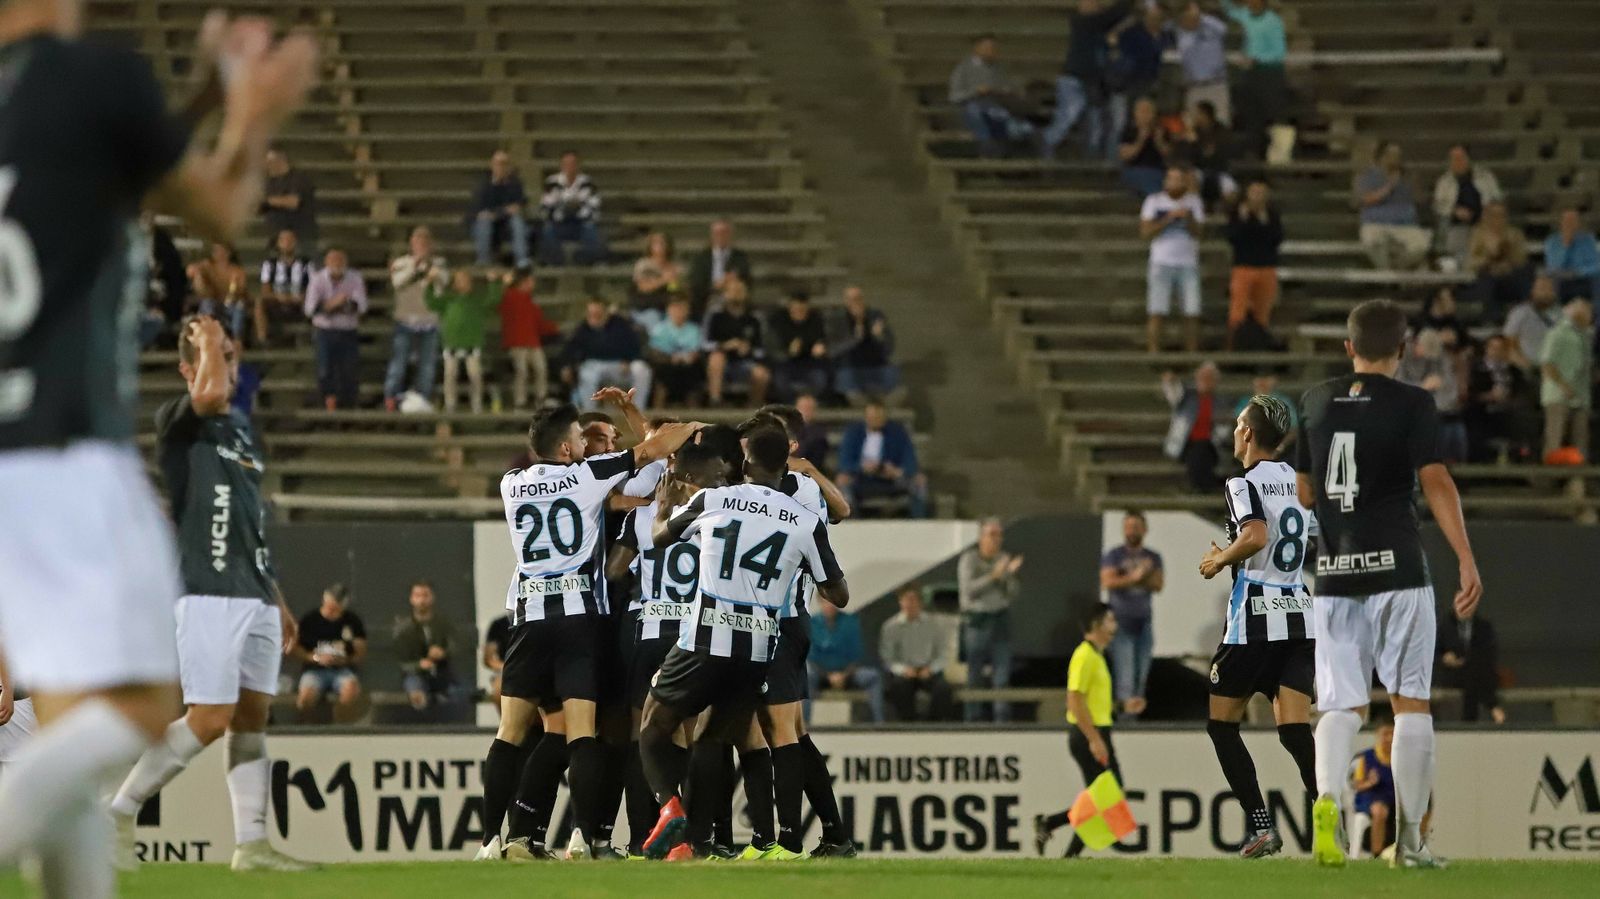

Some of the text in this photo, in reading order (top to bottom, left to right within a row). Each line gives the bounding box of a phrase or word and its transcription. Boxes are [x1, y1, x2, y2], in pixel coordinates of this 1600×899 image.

[510, 474, 579, 498] J.FORJAN
[1325, 432, 1360, 512] 4
[515, 497, 583, 563] 20
[722, 497, 800, 526] MUSA. BK
[712, 518, 788, 591] 14
[1273, 507, 1304, 572] 8
[643, 542, 700, 603] 19
[703, 608, 715, 624] LA
[1253, 600, 1269, 612] LA
[844, 755, 1020, 783] INDUSTRIAS
